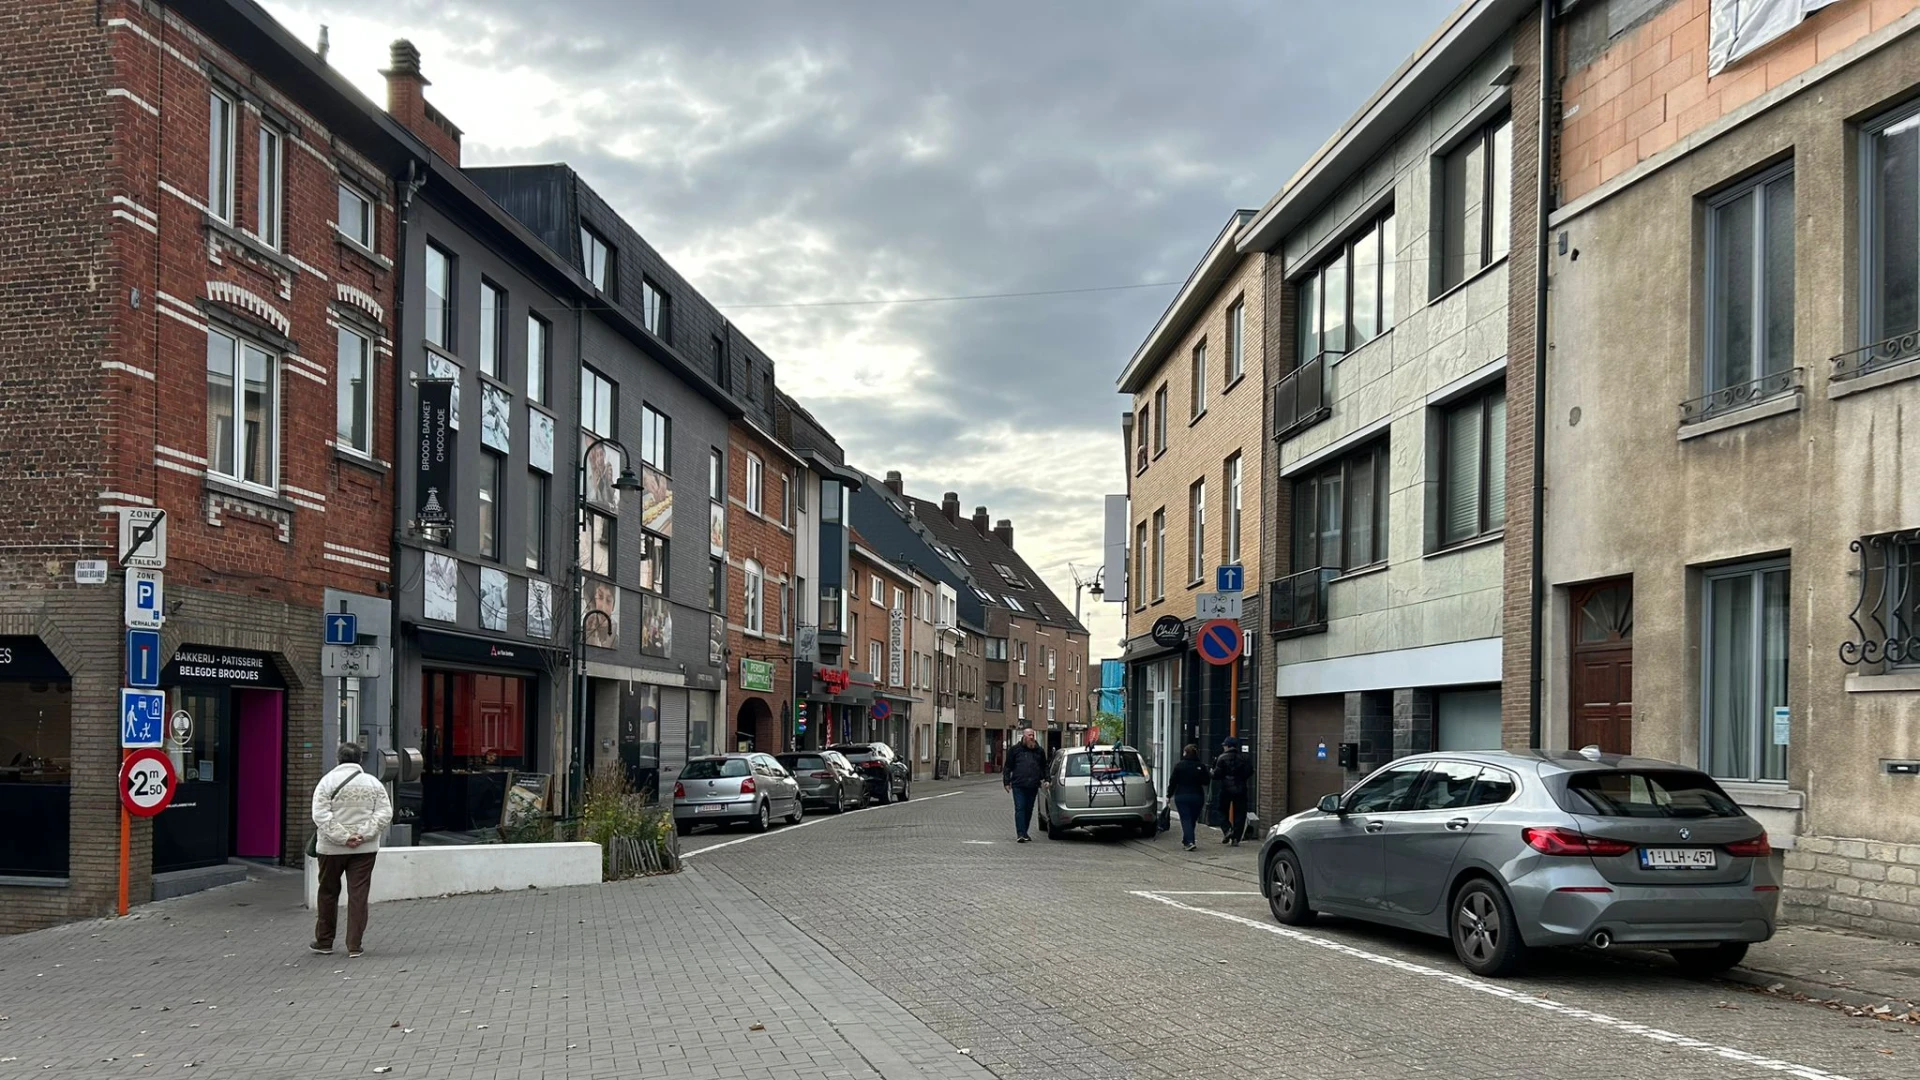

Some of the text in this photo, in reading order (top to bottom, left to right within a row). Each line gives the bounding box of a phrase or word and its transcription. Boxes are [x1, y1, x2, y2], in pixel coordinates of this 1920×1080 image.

[421, 400, 431, 471] BROOD BANKET
[435, 408, 445, 462] CHOCOLADE
[130, 510, 157, 519] ZONE
[136, 572, 155, 580] ZONE
[139, 585, 152, 605] P
[1155, 623, 1181, 637] Chill
[174, 651, 215, 664] BAKKERIJ
[221, 655, 263, 668] PATISSERIE
[179, 665, 259, 680] BELEGDE BROODJES
[134, 770, 159, 797] 2 m
[149, 784, 162, 795] 50
[1649, 850, 1713, 864] 1-LLH-457
